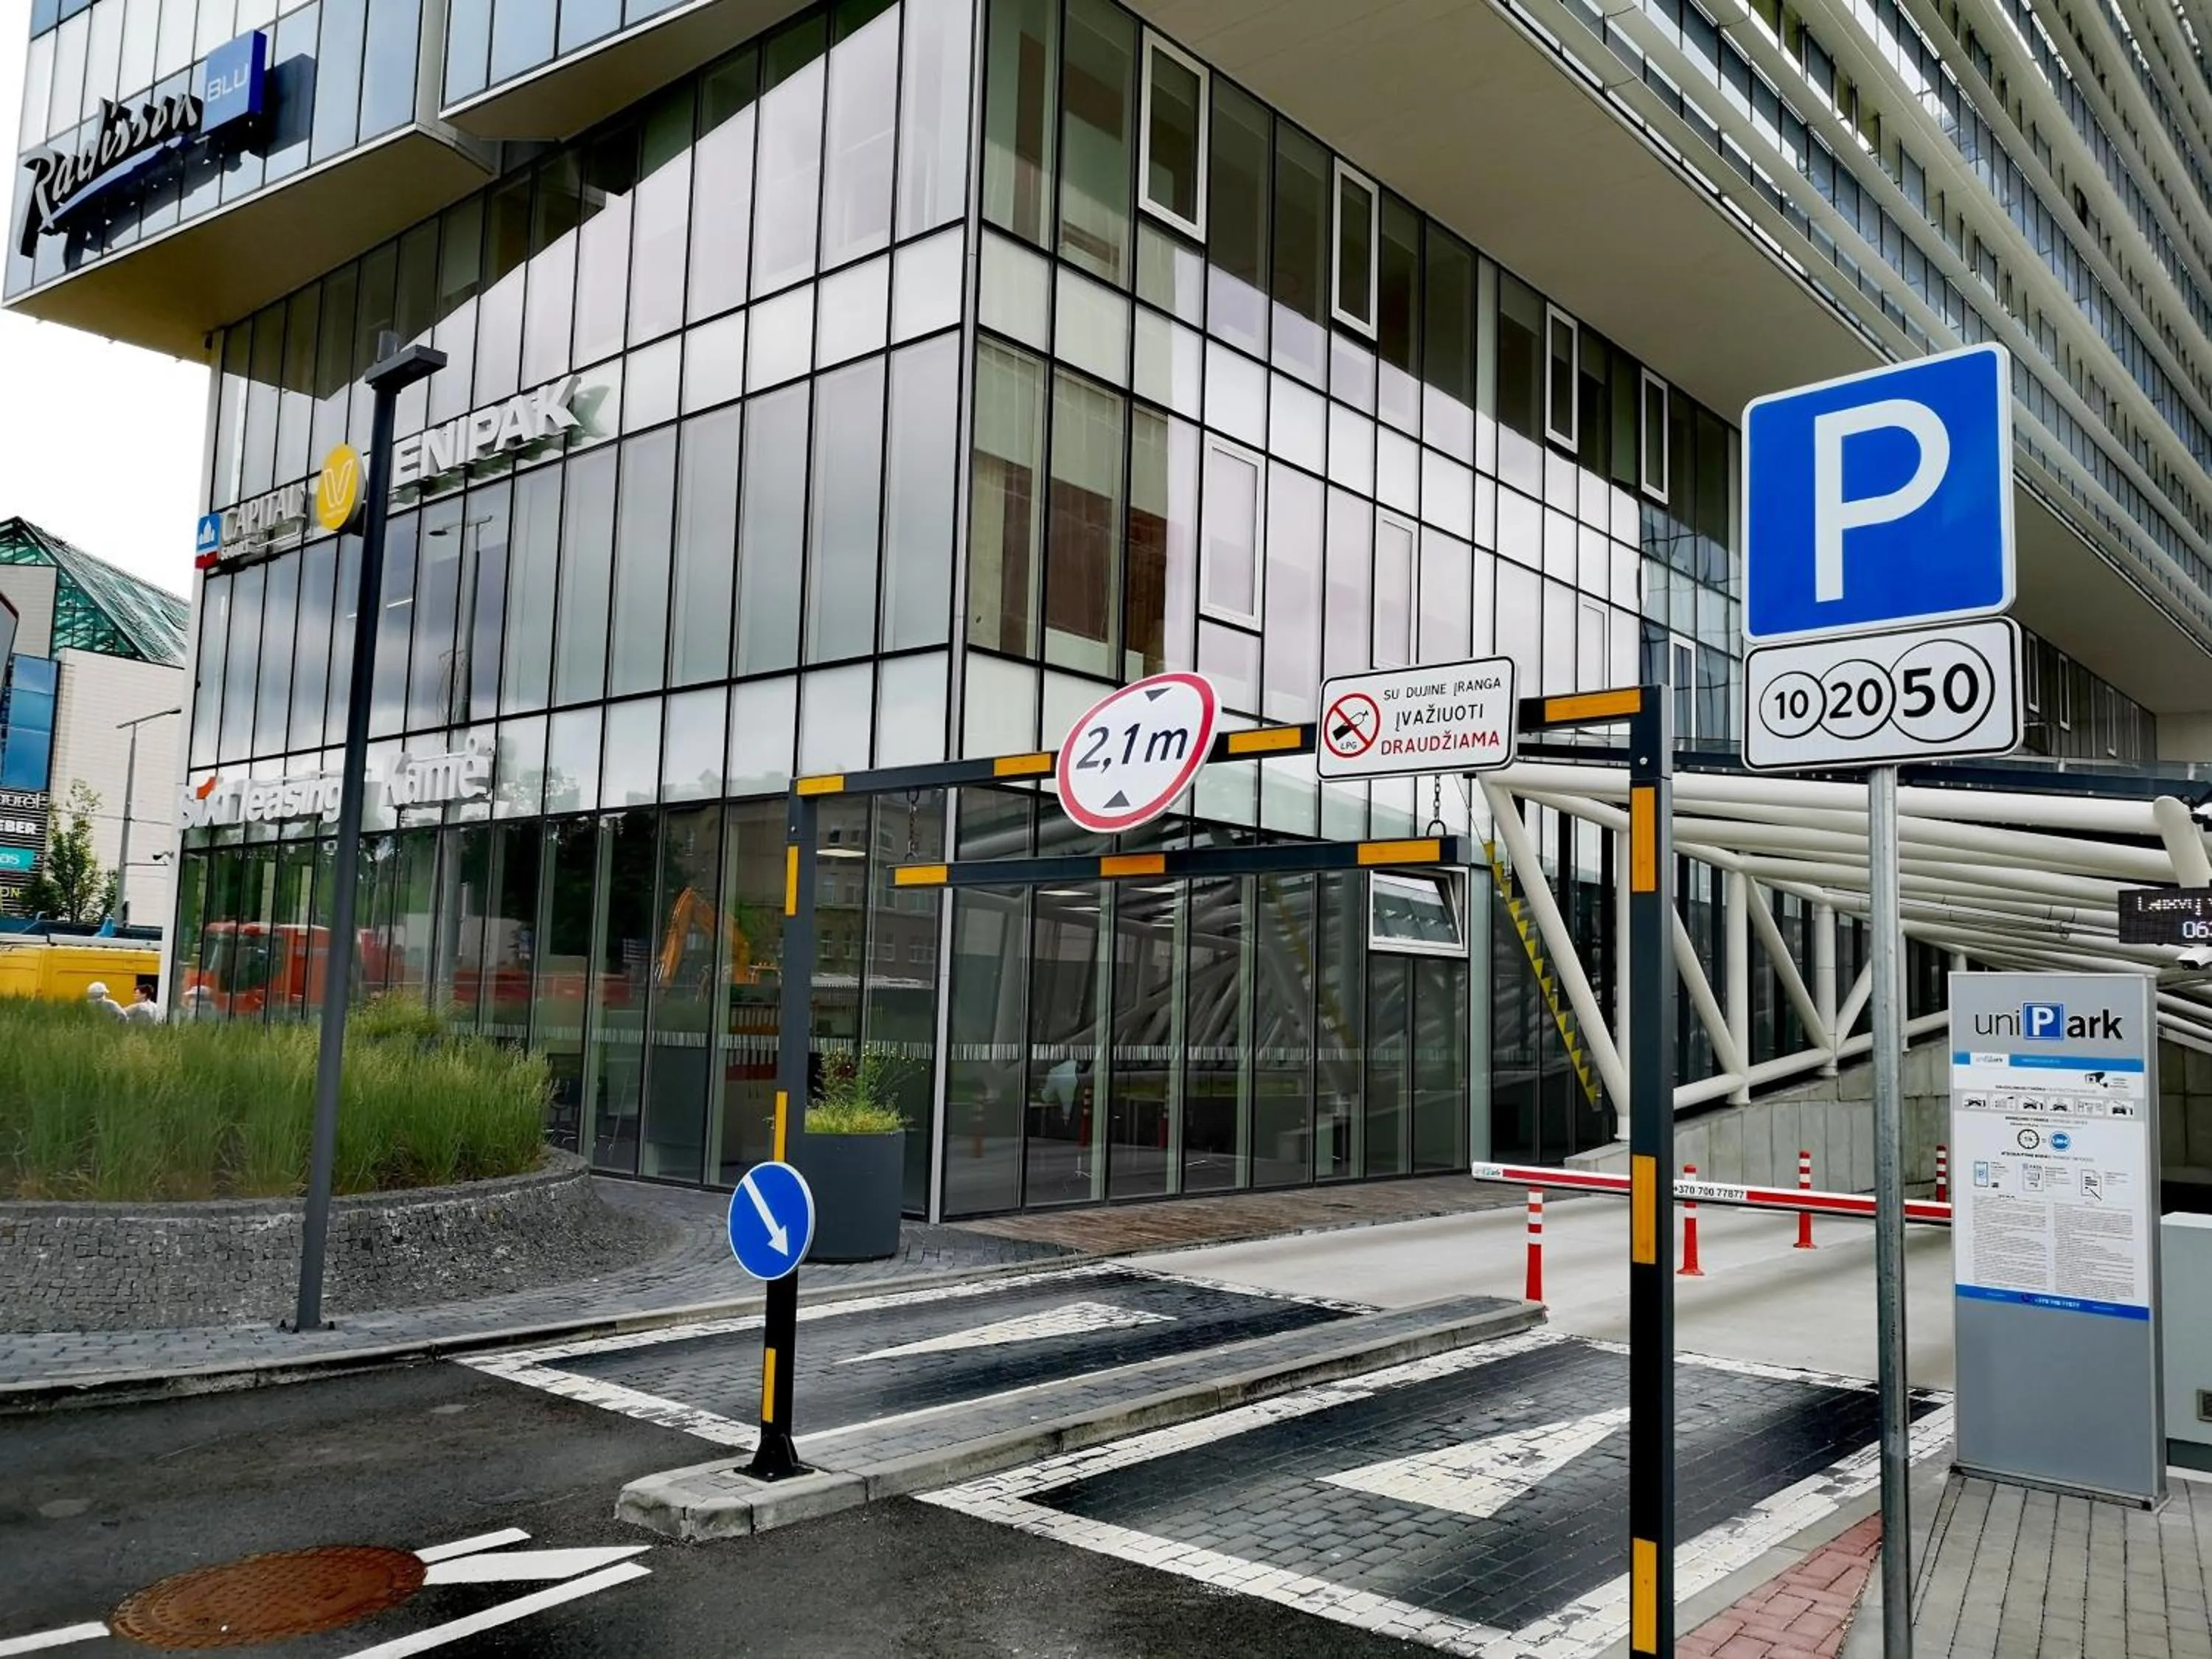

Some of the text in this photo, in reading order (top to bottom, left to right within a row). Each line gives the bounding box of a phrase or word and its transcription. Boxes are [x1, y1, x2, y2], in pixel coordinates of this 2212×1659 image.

[20, 62, 249, 234] Radisson BLU
[363, 375, 581, 488] ENIPAK
[222, 484, 307, 543] CAPITAL
[1814, 399, 1950, 603] P
[1383, 677, 1501, 700] SU DUJINE ĮRANGA
[1774, 663, 1979, 720] 10 20 50
[1395, 703, 1484, 731] ĮVAŽIUOTI
[1340, 741, 1357, 750] LPG
[1381, 729, 1500, 756] DRAUDŽIAMA
[240, 778, 343, 823] leasing
[1698, 1186, 1714, 1197] 700
[1717, 1188, 1745, 1198] 77877
